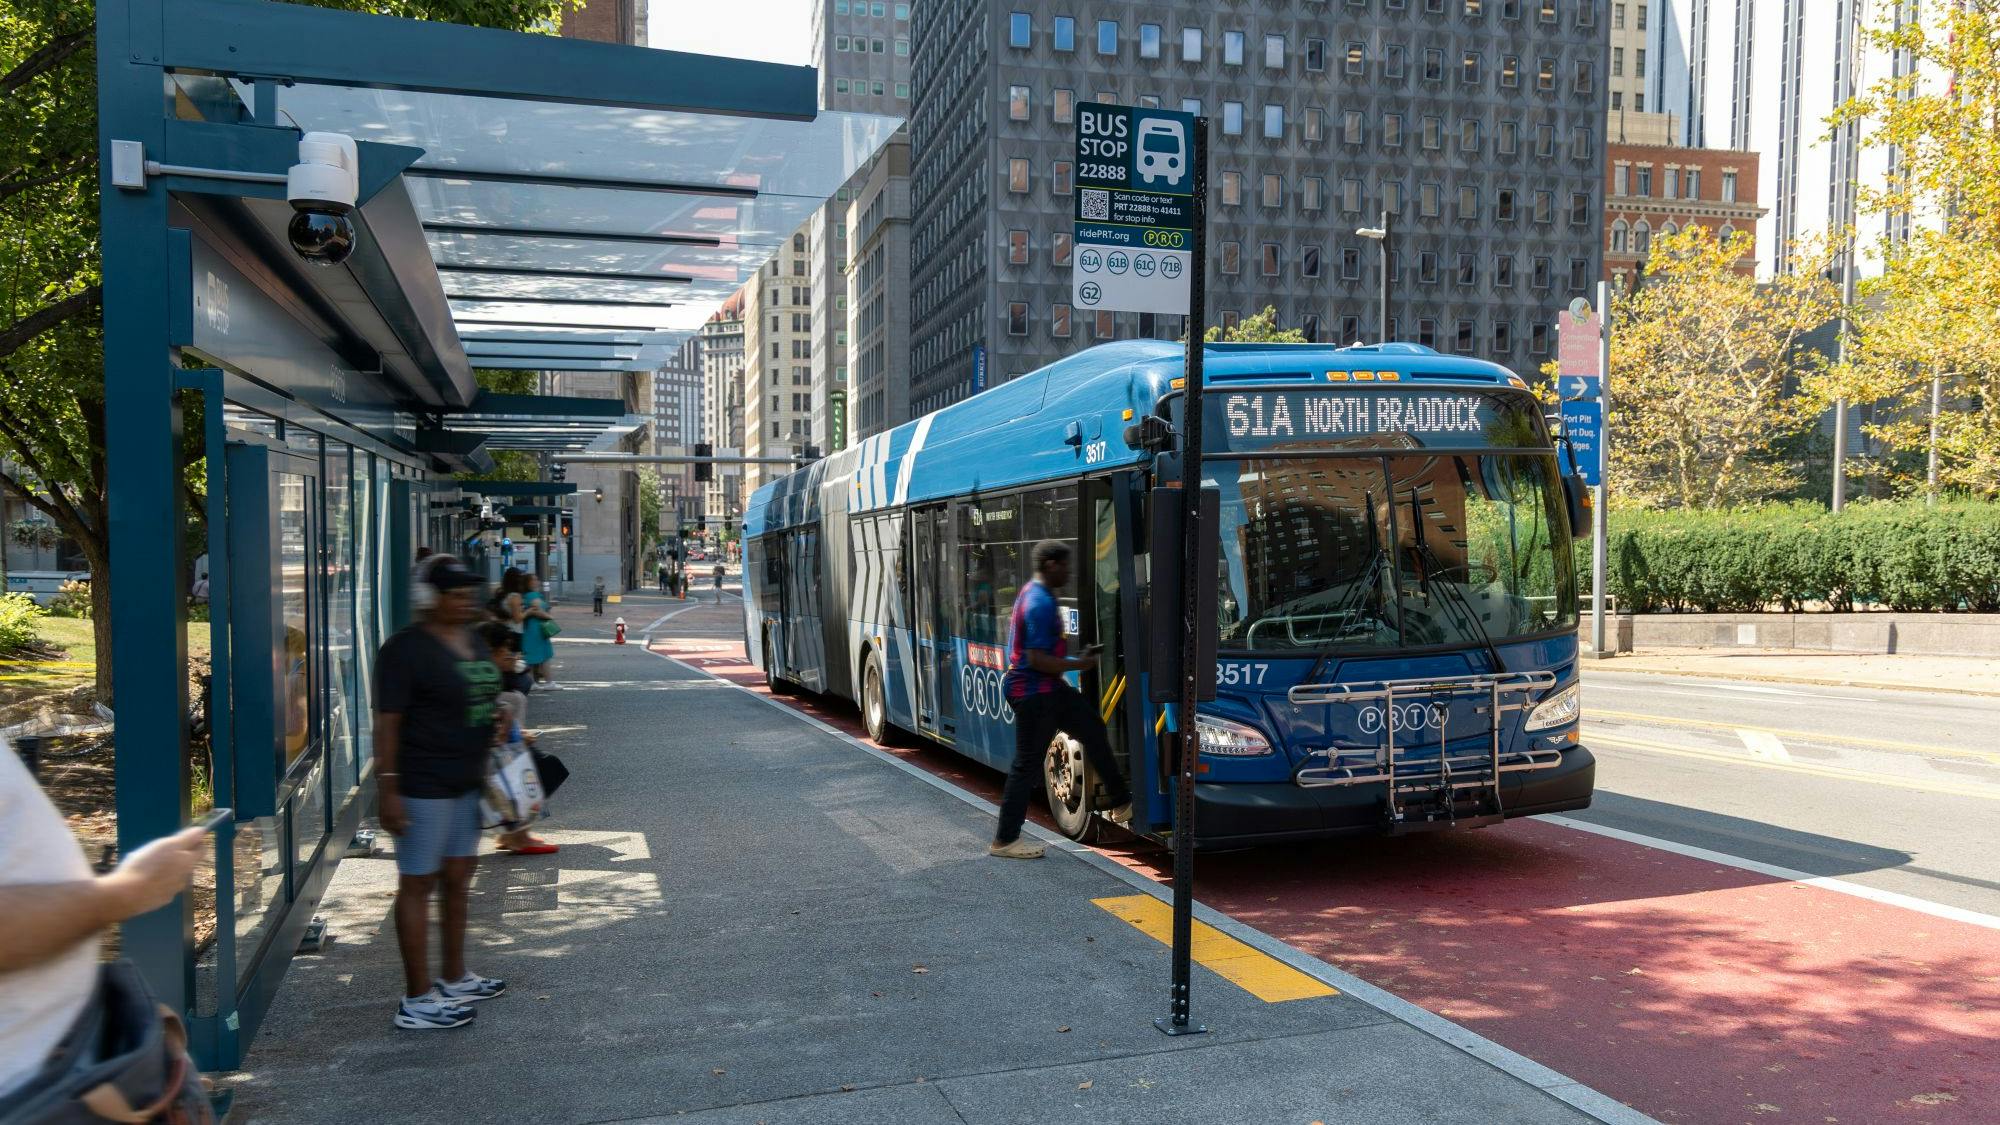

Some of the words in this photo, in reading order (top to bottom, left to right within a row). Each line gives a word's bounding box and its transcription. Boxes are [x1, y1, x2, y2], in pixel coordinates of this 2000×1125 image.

[1080, 111, 1128, 138] BUS
[1080, 138, 1128, 158] STOP
[1079, 162, 1126, 180] 22888
[1113, 192, 1131, 201] Scan
[1131, 194, 1150, 203] code
[1159, 196, 1173, 204] text
[1113, 202, 1128, 211] PRT
[1128, 203, 1151, 213] 22888
[1152, 206, 1160, 214] to
[1160, 206, 1181, 216] 41411
[1113, 212, 1124, 221] for
[1124, 214, 1141, 224] stop
[1141, 214, 1156, 224] info
[1079, 228, 1130, 243] ridePRT.org
[1145, 231, 1181, 247] PRT
[1081, 255, 1100, 267] 61A
[1109, 257, 1127, 269] 61B
[1135, 259, 1154, 271] 61C
[1163, 261, 1180, 273] 71B
[1080, 286, 1099, 300] G2
[1226, 395, 1293, 436] 61A
[1305, 398, 1369, 432] NORTH
[1376, 397, 1481, 432] BRADDOCK
[1563, 414, 1578, 423] Fort
[1579, 414, 1592, 424] Pitt
[1086, 440, 1106, 464] 3517
